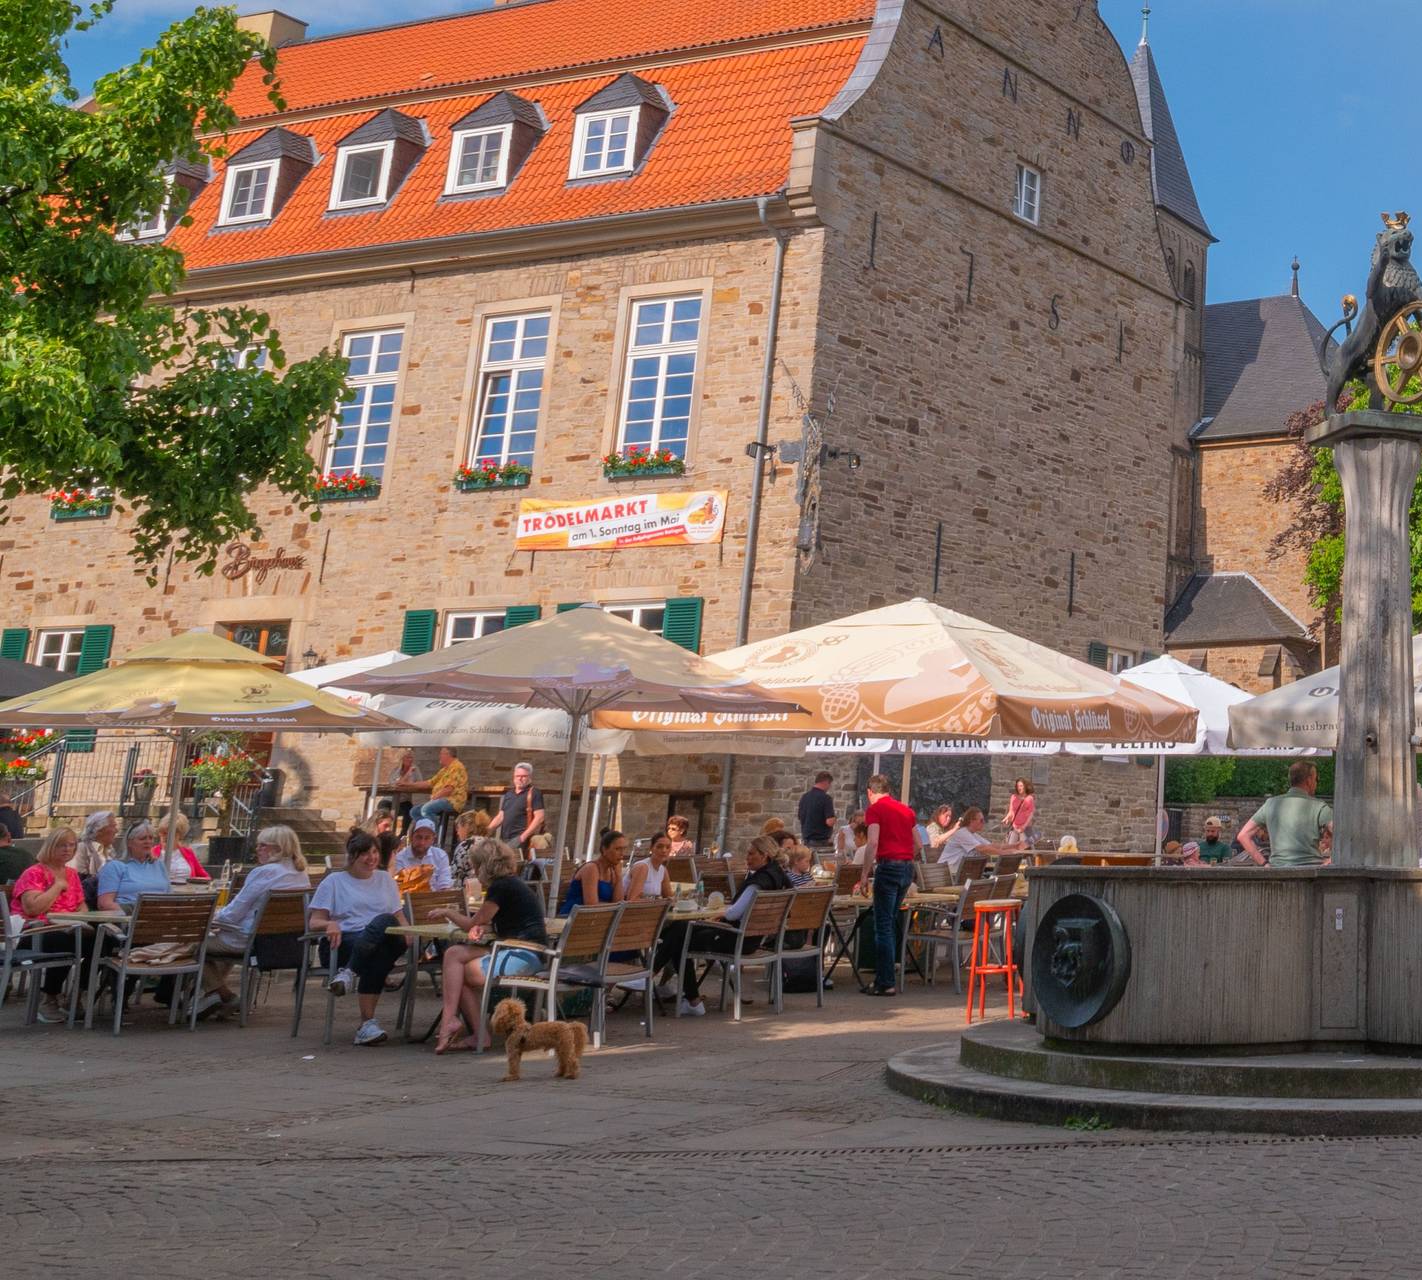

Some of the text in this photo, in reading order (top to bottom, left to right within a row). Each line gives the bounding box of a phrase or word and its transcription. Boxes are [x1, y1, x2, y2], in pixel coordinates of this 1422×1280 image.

[523, 499, 649, 533] TRÖDELMARKT
[572, 530, 588, 541] am
[599, 520, 641, 537] Sonntag
[643, 519, 657, 530] im
[660, 512, 681, 526] Mai
[1031, 706, 1073, 733] Original
[1075, 703, 1111, 733] Schlüssel
